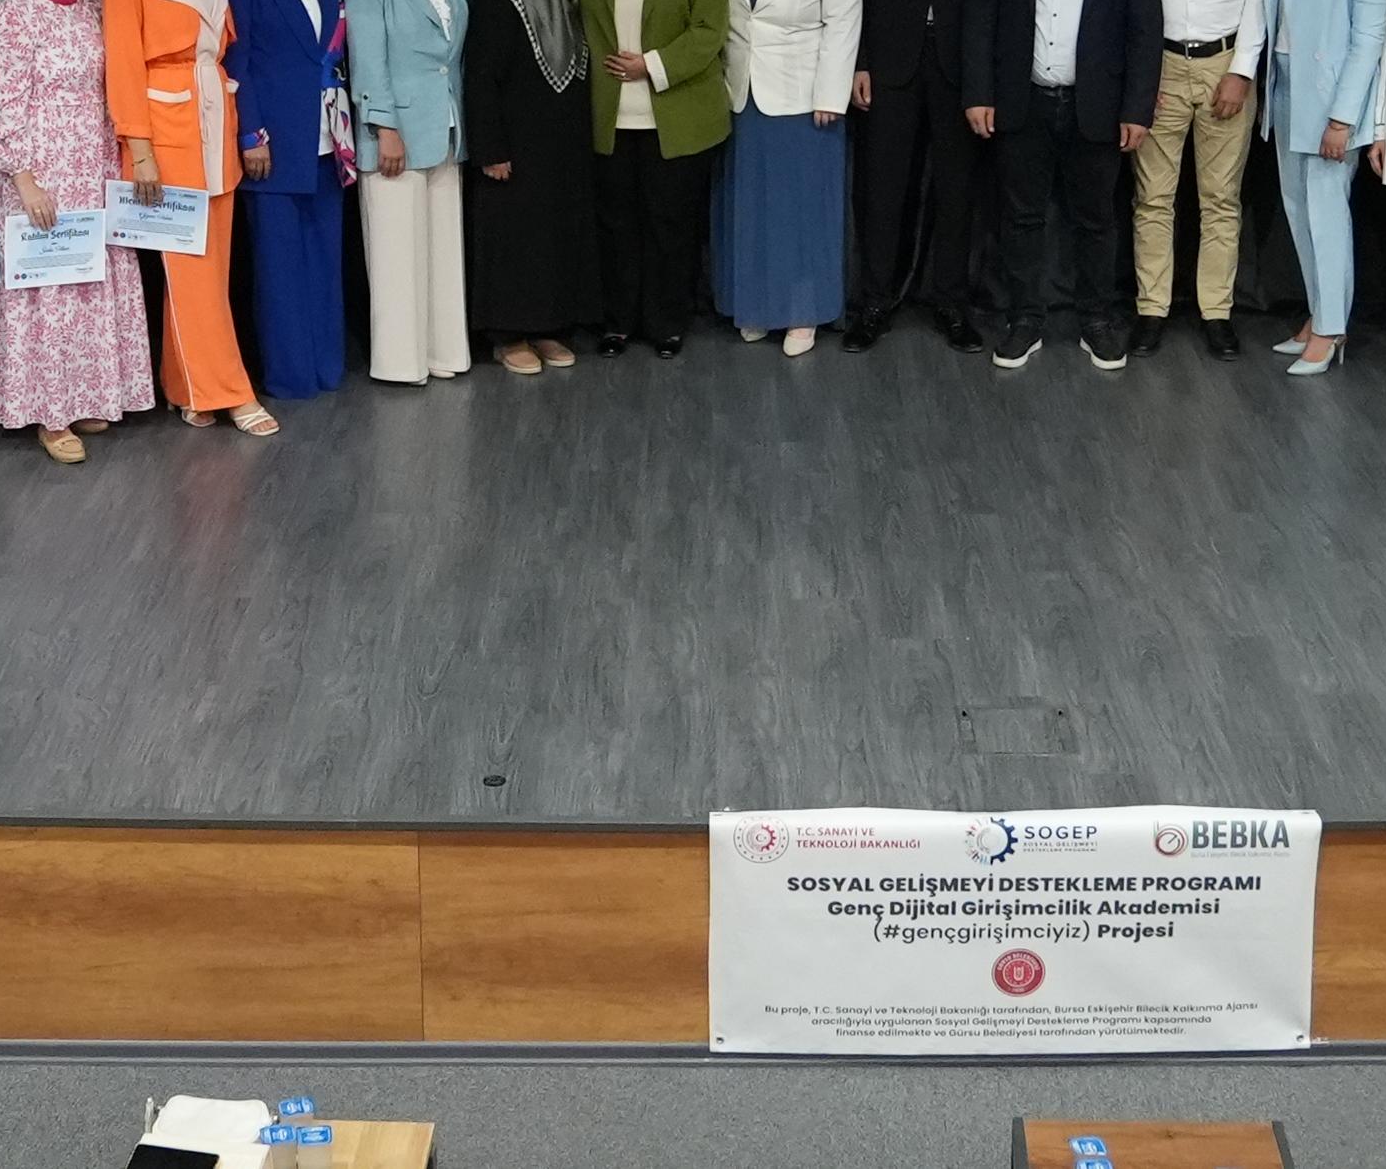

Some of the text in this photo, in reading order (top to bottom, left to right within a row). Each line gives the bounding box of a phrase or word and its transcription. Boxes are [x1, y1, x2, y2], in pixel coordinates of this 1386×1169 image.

[797, 826, 875, 837] T.C. SANAYİ VE
[1024, 826, 1098, 839] SOGEP
[1192, 820, 1290, 848] BEBKA
[797, 838, 921, 849] TEKNOLOJİ BAKANLIĞI
[787, 873, 1261, 897] SOSYAL GELİŞMEYİ DESTEKLEME PROGRAMI
[827, 898, 1220, 921] Genç Dijital Girişimcilik Akademisi
[874, 917, 1174, 943] (#gençgirişimciyiz) Projesi
[765, 1006, 778, 1014] Bu
[835, 1006, 872, 1016] Sanayi
[890, 1006, 938, 1016] Teknoloji
[940, 1006, 990, 1016] Bakanlığı
[1055, 1005, 1084, 1013] Bursa
[1087, 1004, 1133, 1015] Eskişehir
[874, 1017, 933, 1028] uygulanan
[935, 1017, 970, 1028] Sosyal
[1027, 1017, 1090, 1026] Destekleme
[835, 1028, 875, 1037] finanse
[878, 1028, 931, 1037] edilmekte
[949, 1028, 980, 1037] Gürsu
[983, 1028, 1037, 1038] Belediyesi
